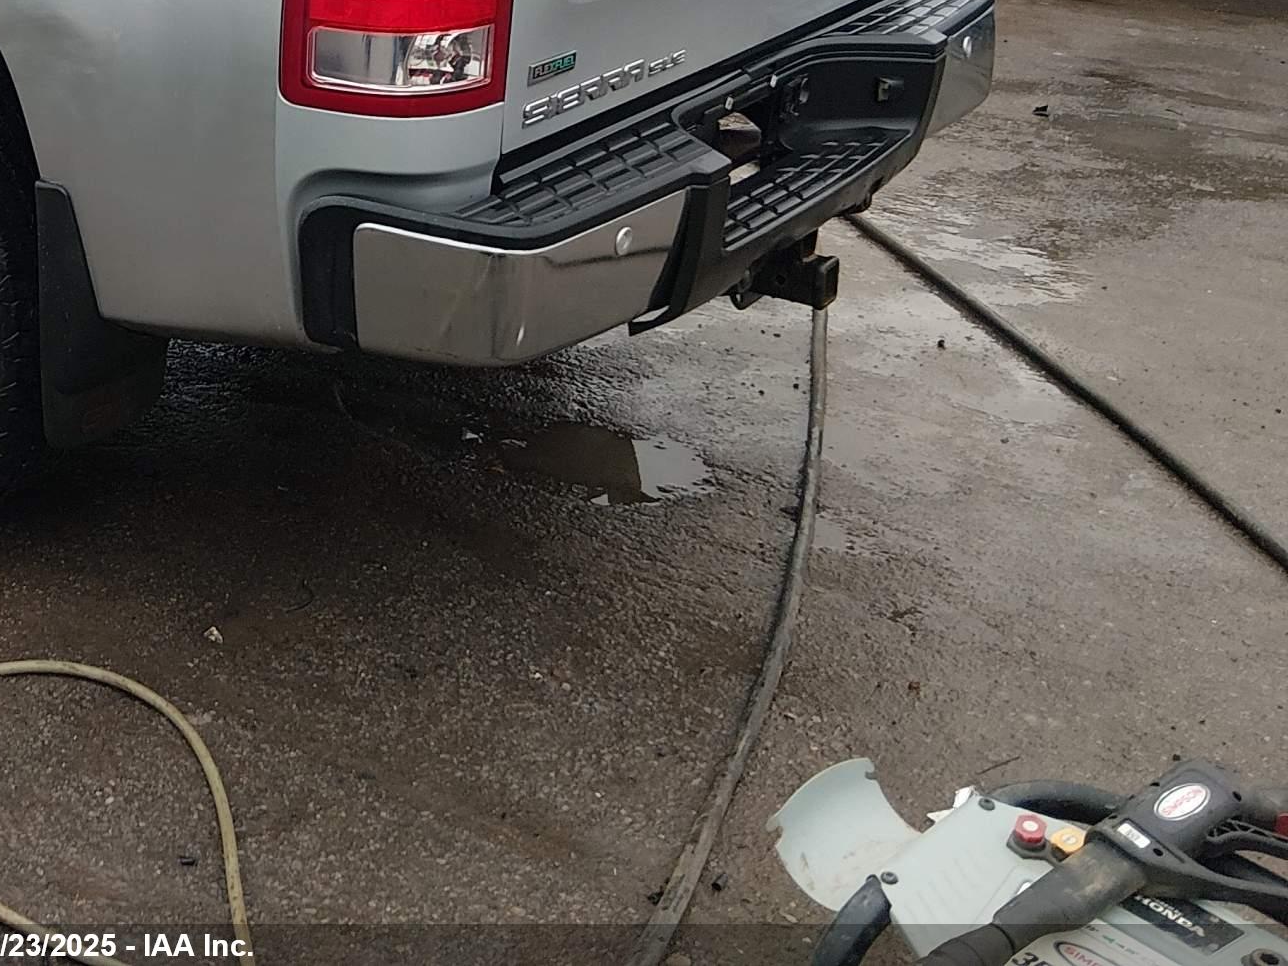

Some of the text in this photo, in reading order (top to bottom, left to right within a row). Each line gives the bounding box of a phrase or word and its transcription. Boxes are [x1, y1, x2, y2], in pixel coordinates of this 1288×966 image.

[522, 49, 687, 128] SIERRA SLE
[1134, 895, 1206, 938] HONDA
